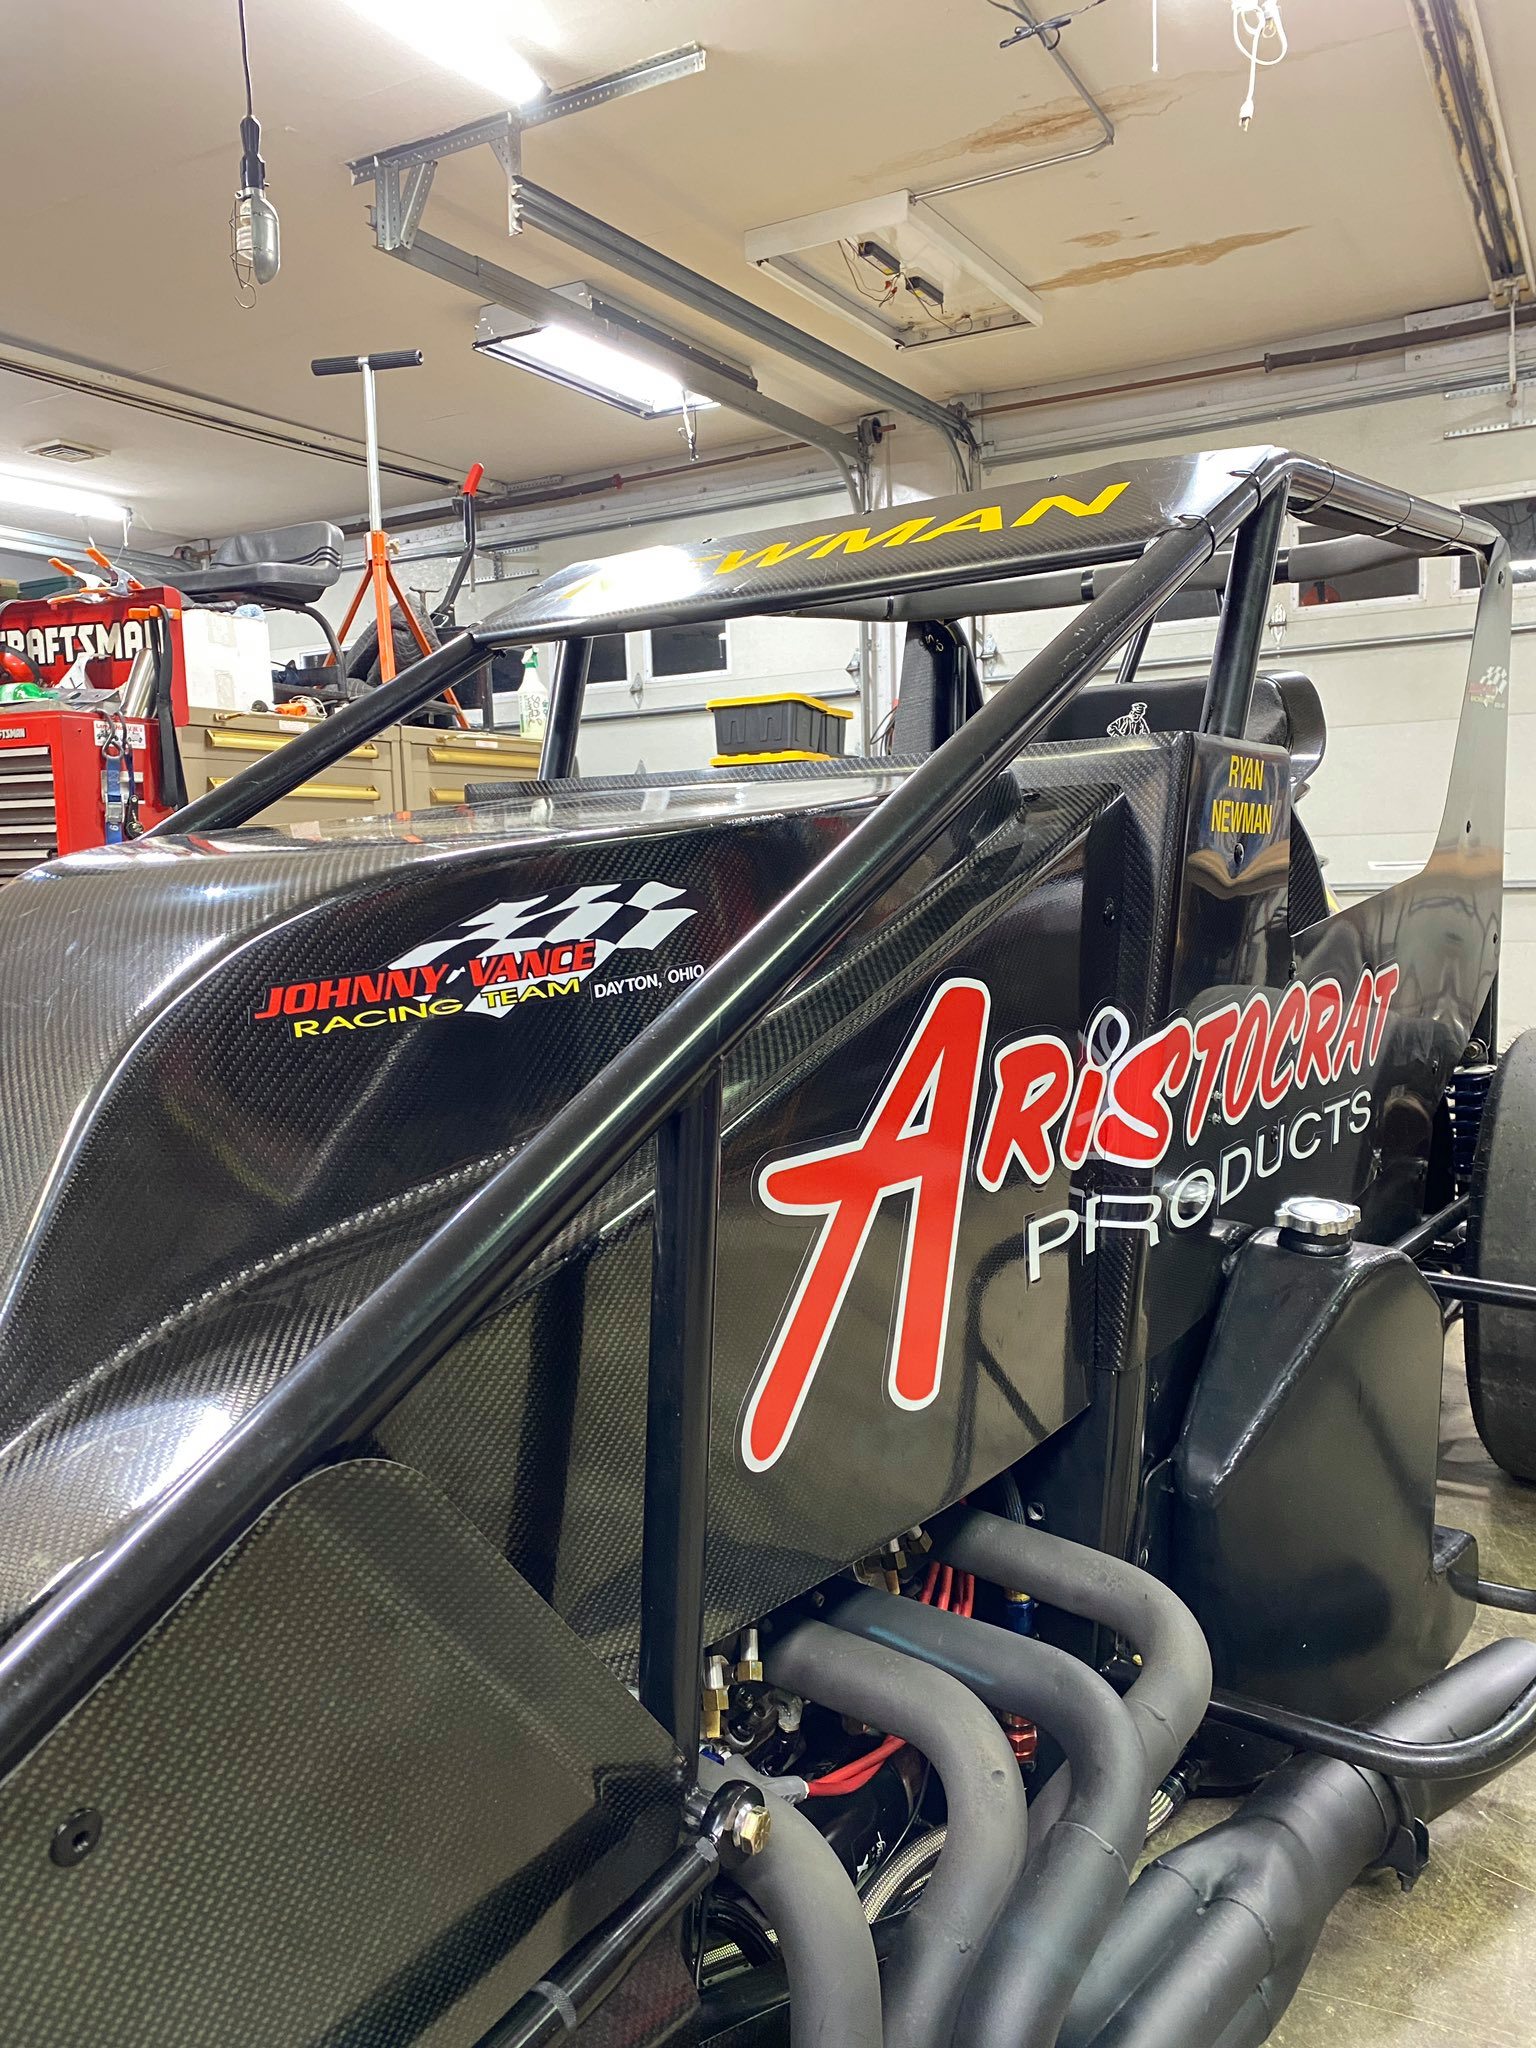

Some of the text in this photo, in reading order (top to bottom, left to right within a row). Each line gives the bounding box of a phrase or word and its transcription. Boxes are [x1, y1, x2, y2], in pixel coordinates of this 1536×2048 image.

[558, 482, 1131, 600] WMAN
[1228, 754, 1265, 791] RYAN
[1211, 799, 1272, 835] NEWMAN
[254, 939, 597, 1019] JOHNNY VANCE
[293, 978, 580, 1038] RACING TEAM
[594, 964, 705, 999] DAYTON, OHIO
[1027, 1089, 1373, 1284] PRODUCTS
